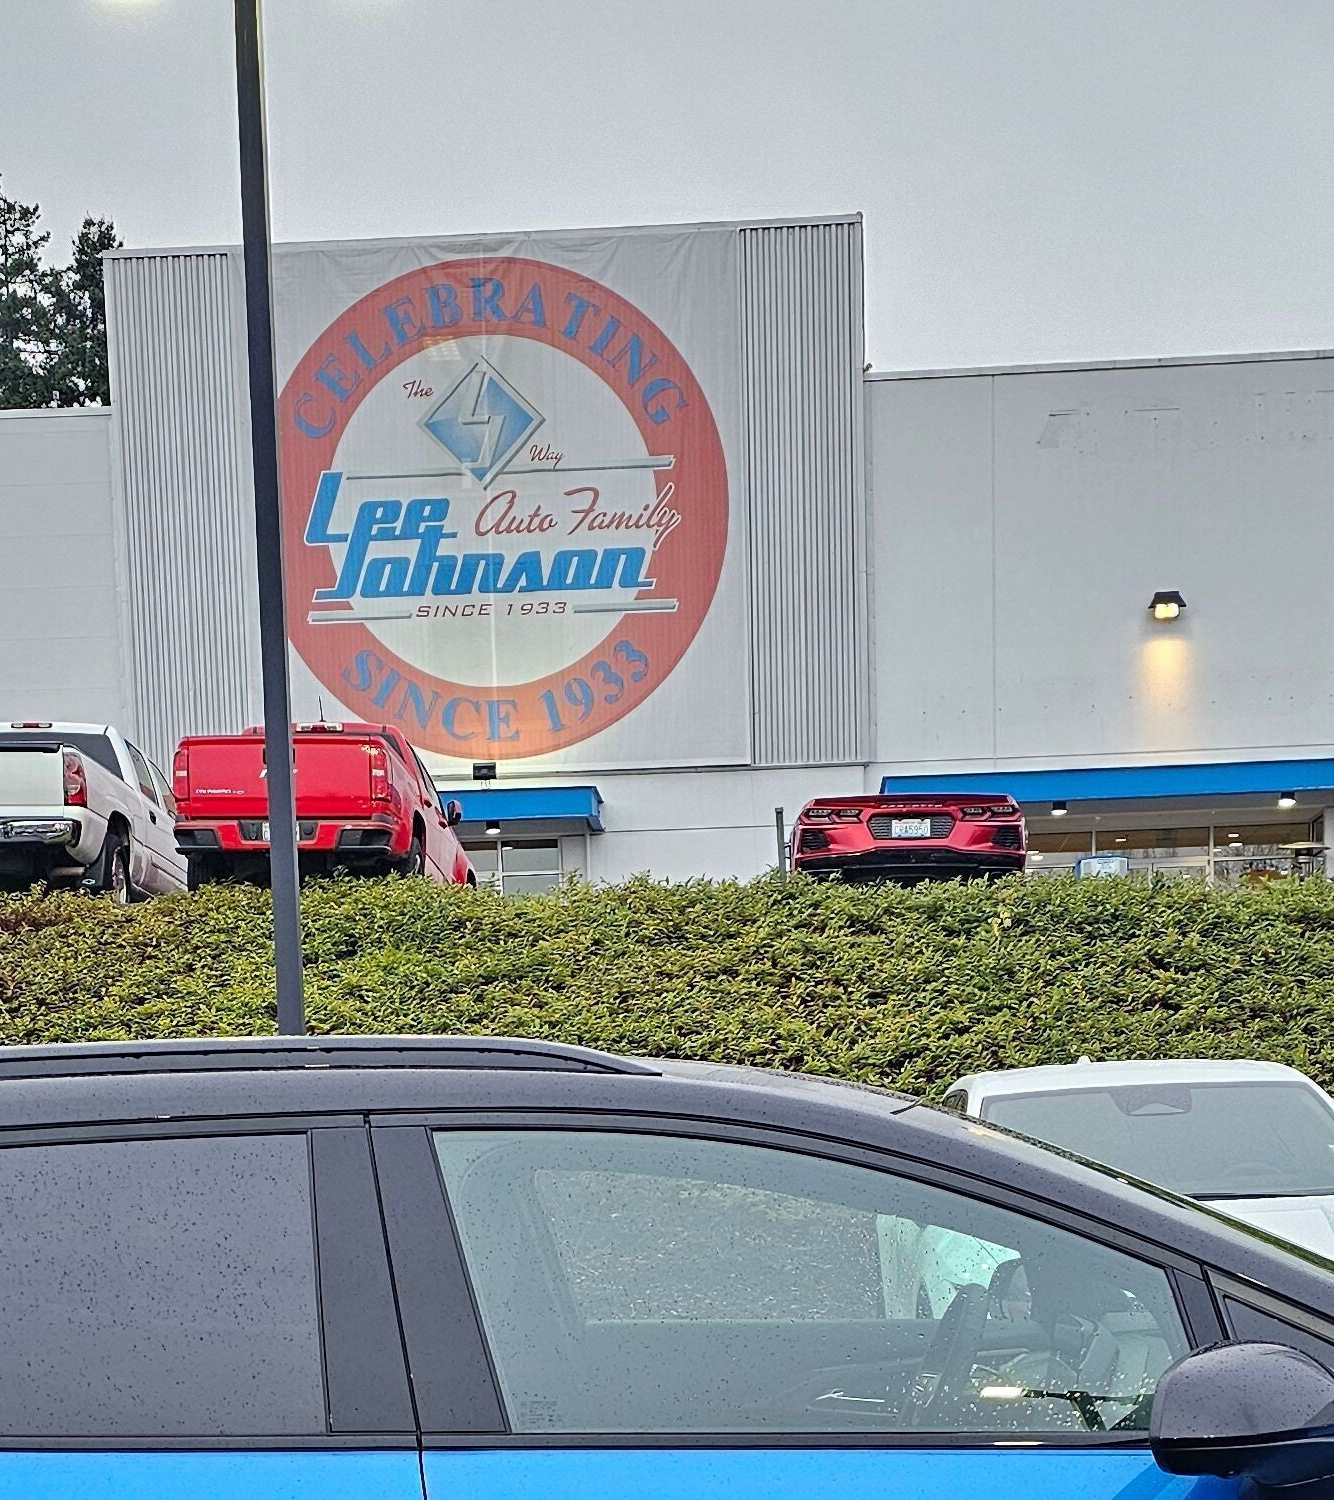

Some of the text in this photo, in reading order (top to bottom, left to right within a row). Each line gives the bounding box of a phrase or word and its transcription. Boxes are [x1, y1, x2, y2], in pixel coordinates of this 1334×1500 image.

[293, 277, 688, 440] CELEBRATING
[403, 380, 434, 398] The
[529, 444, 566, 469] Way
[305, 471, 458, 544] Lee
[474, 485, 680, 549] Auto Family
[313, 526, 655, 601] Johnson
[416, 601, 568, 618] SINCE 1933
[341, 640, 650, 743] SINCE 1933
